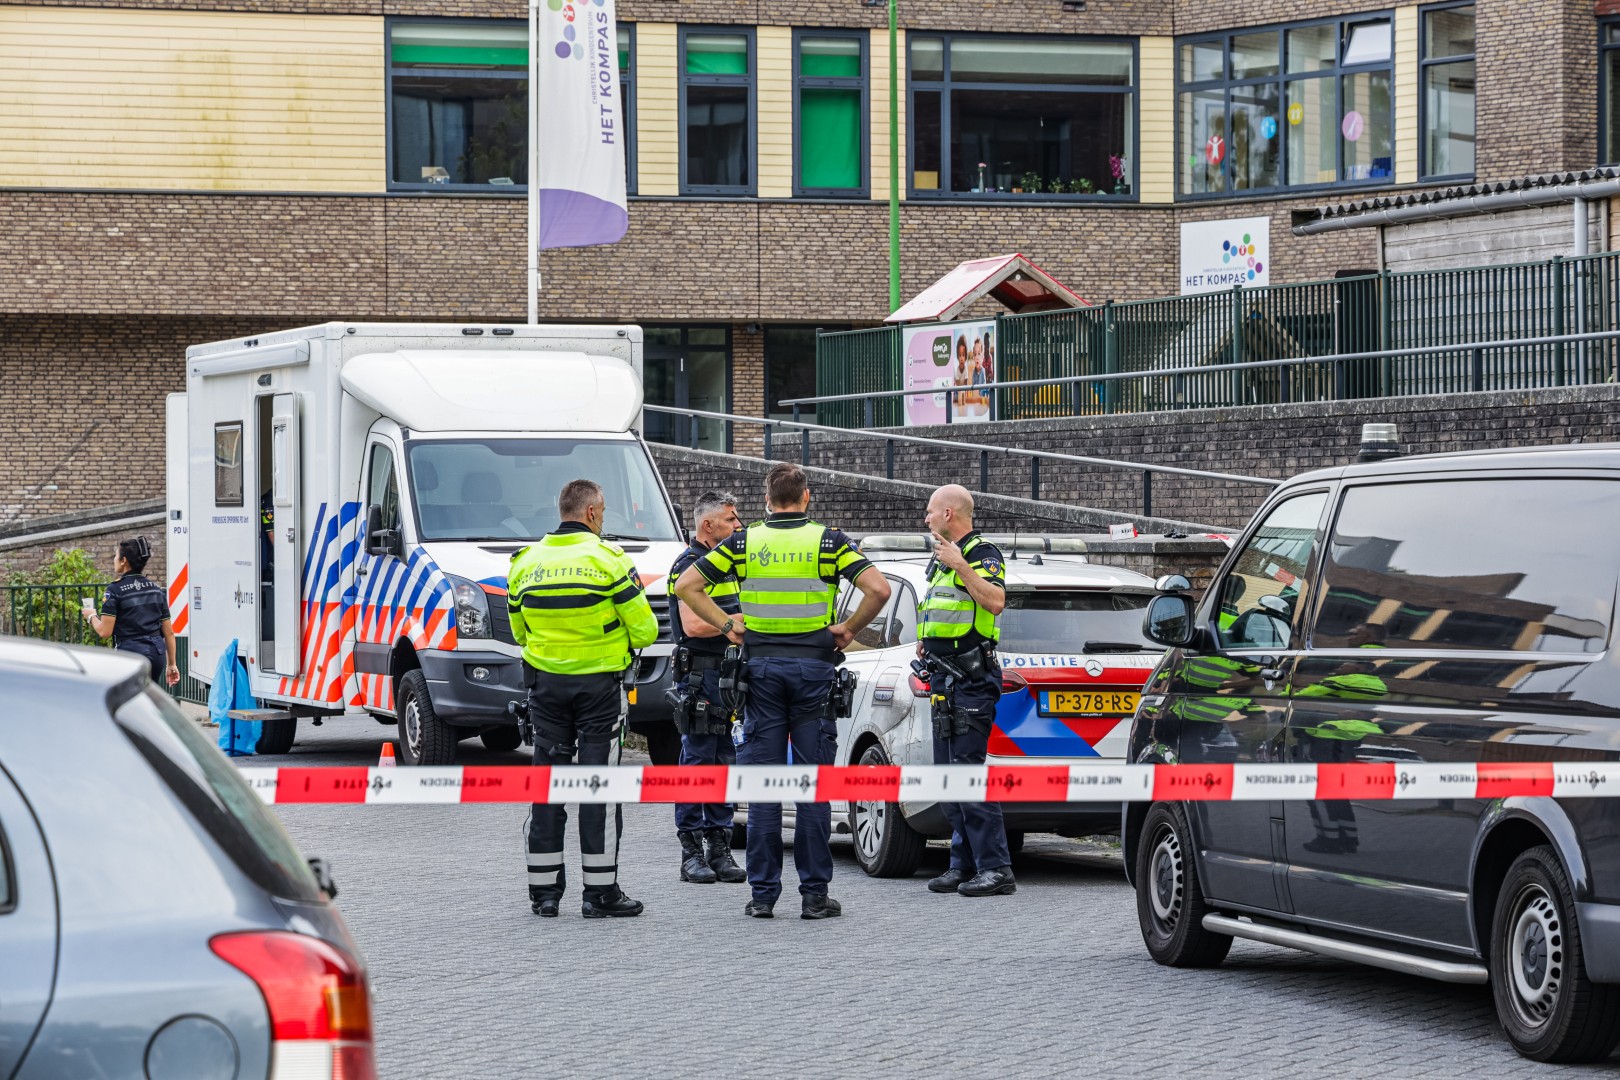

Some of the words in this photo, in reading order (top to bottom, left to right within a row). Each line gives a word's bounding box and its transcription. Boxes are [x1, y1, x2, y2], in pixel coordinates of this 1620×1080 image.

[597, 12, 612, 97] KOMPAS
[601, 104, 614, 144] HET
[1186, 275, 1204, 286] HET
[1207, 273, 1246, 285] KOMPAS
[1002, 657, 1078, 667] POLITIE
[1055, 694, 1134, 710] P-378-RS
[257, 778, 281, 788] NIET
[419, 778, 476, 787] BETREDEN
[478, 778, 502, 787] NIET
[636, 777, 690, 787] BETREDEN
[692, 777, 715, 786] NIET
[844, 777, 897, 786] BETREDEN
[901, 777, 921, 785] NIET
[1047, 776, 1098, 785] BETREDEN
[1101, 776, 1122, 785] NIET
[1246, 776, 1296, 784] BETREDEN
[1298, 776, 1319, 784] NIET
[1439, 775, 1488, 783] BETREDEN
